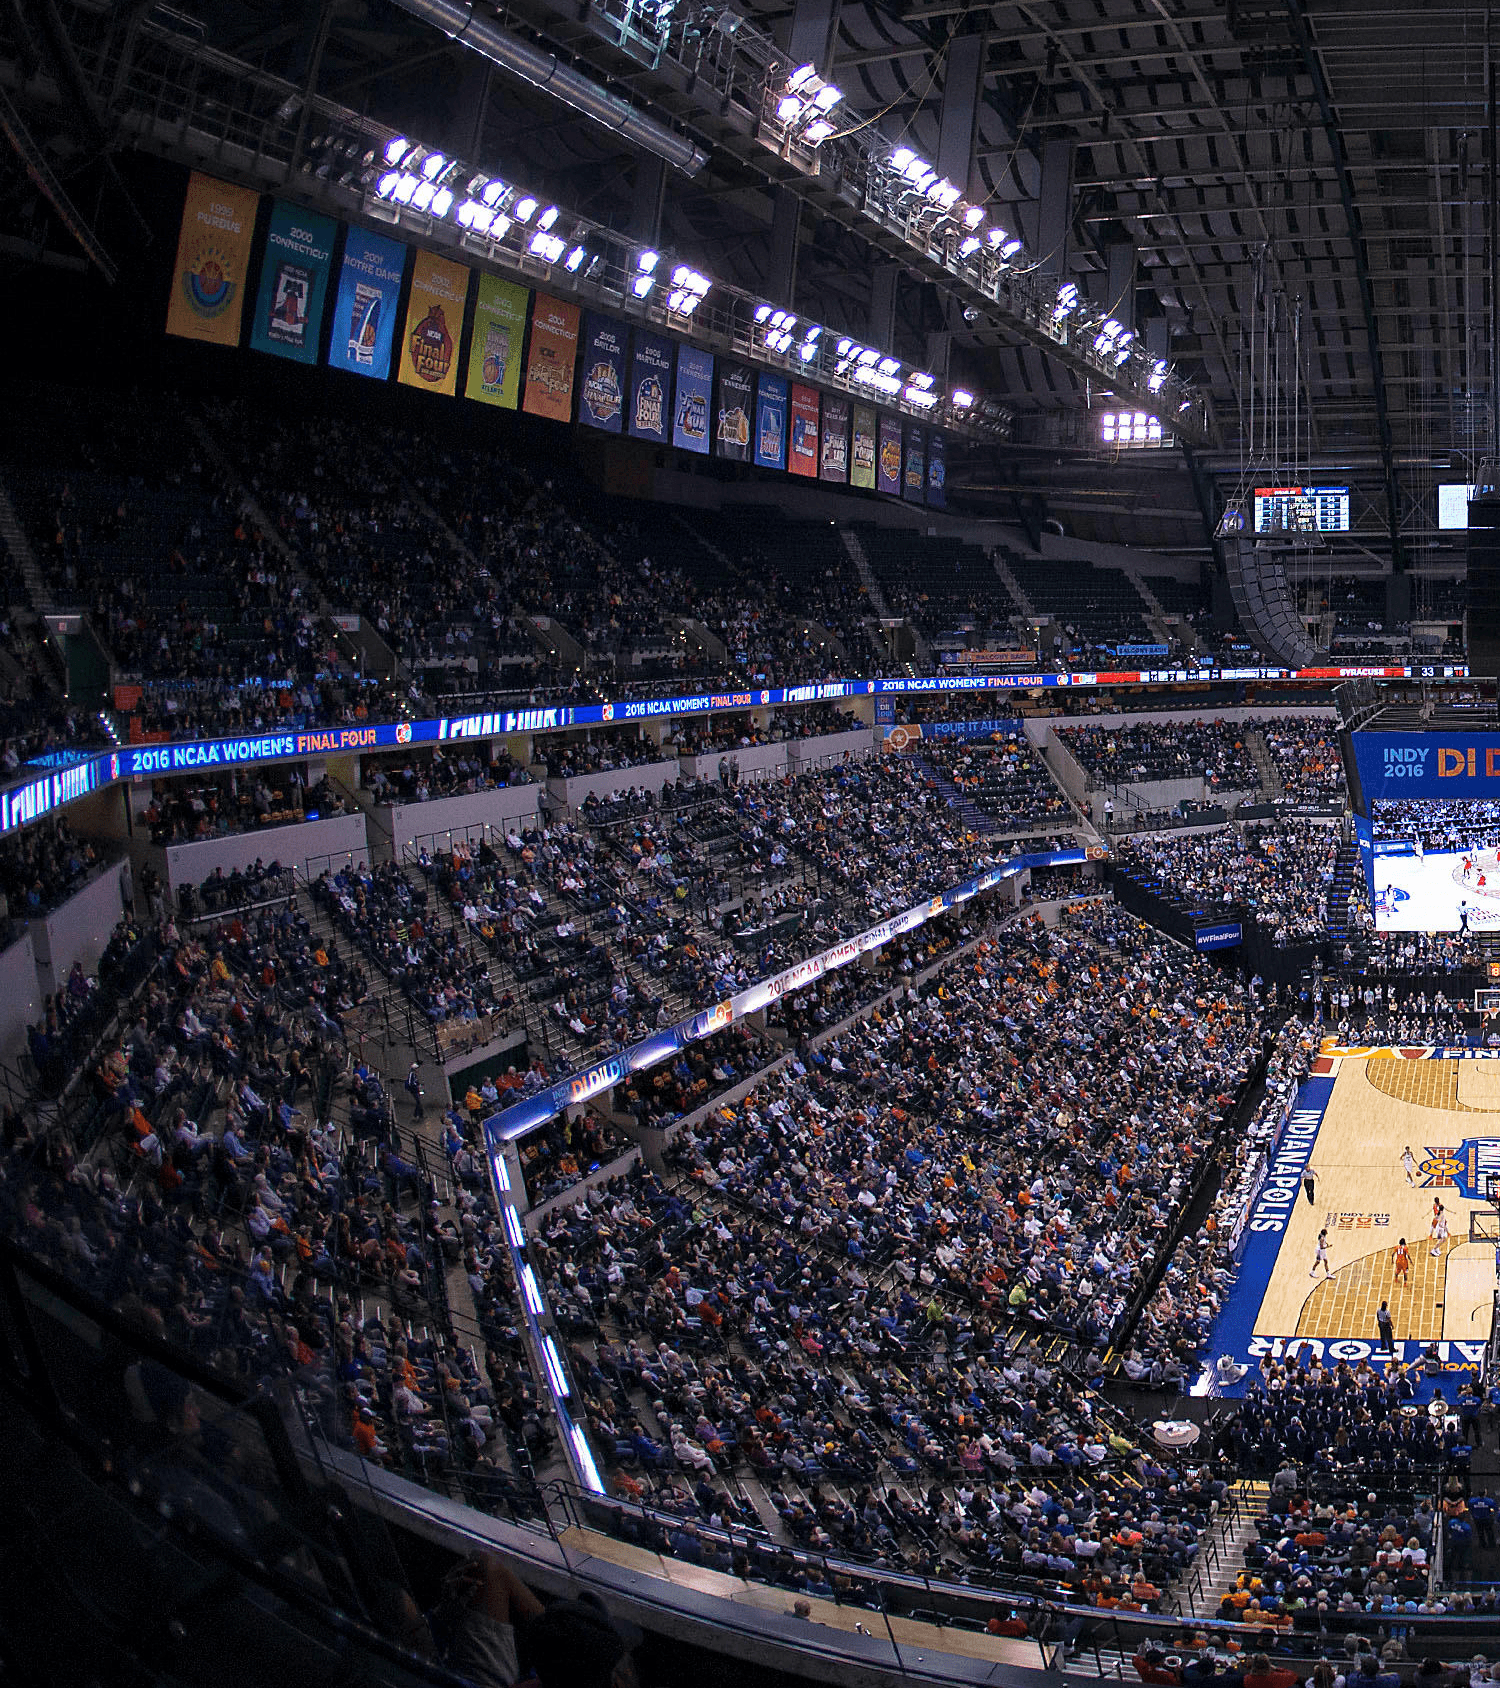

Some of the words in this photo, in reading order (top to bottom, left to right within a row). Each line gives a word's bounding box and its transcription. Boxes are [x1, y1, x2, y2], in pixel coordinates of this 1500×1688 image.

[197, 212, 240, 234] PURDUE
[290, 227, 312, 244] 2000
[270, 234, 328, 260] CONNECTICUT
[364, 251, 384, 264] 2001
[344, 255, 374, 275] NOTRE
[375, 267, 400, 283] DAME
[414, 280, 465, 302] CONNECTICUT
[535, 320, 577, 340] CONNECTICUT
[409, 334, 445, 362] Final
[594, 338, 620, 354] BAYLOR
[636, 353, 670, 370] MARYLAND
[1340, 668, 1384, 677] SYRACUSE
[1421, 667, 1434, 676] 33
[882, 681, 905, 691] 2016
[908, 680, 934, 689] NCAA
[938, 677, 986, 688] WOMEN'S
[988, 677, 1016, 687] FINAL
[1017, 676, 1043, 686] FOUR
[625, 705, 645, 716] 2016
[647, 702, 670, 714] NCAA
[672, 698, 710, 712] WOMEN'S
[711, 695, 732, 707] FINAL
[732, 694, 751, 705] FOUR
[934, 722, 965, 734] FOUR
[968, 722, 979, 732] IT
[981, 720, 1002, 732] ALL
[132, 752, 169, 771] 2016
[174, 748, 216, 766] NCAA
[223, 736, 294, 761] WOMEN'S
[298, 735, 339, 752] FINAL
[341, 730, 376, 747] FOUR
[1384, 748, 1430, 763] INDY
[1438, 748, 1476, 776] DI
[1384, 764, 1424, 777] 2016
[1198, 932, 1240, 944] #WFinalFour
[821, 938, 863, 970] WOMEN'S
[571, 1076, 588, 1100] DI
[589, 1065, 608, 1092] DII
[1250, 1110, 1322, 1232] INDIANAPOLIS
[1248, 1338, 1408, 1361] FOUR
